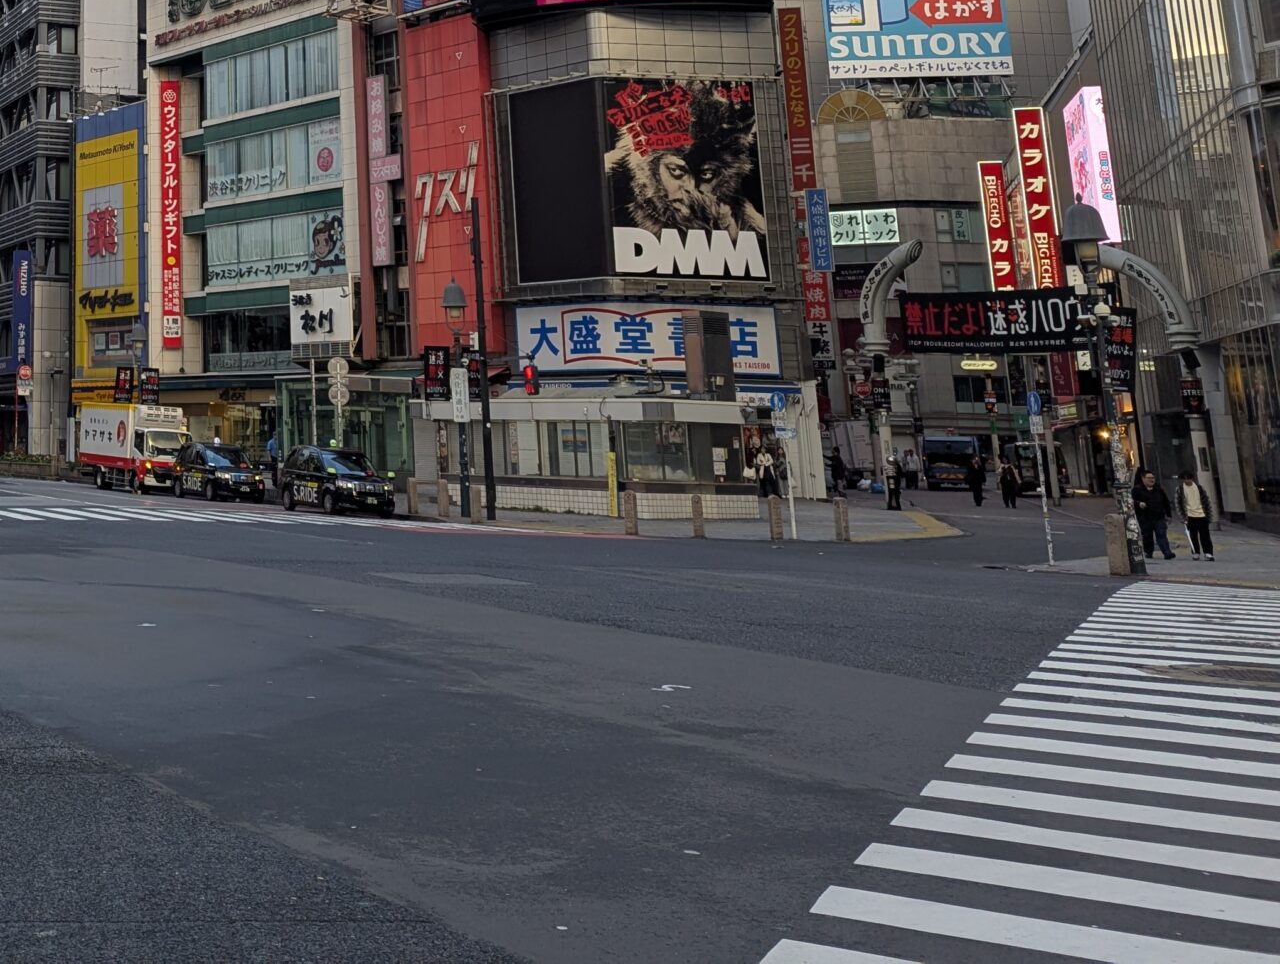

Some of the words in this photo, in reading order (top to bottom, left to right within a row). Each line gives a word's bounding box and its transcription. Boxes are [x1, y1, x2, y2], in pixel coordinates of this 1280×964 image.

[830, 30, 1007, 58] SUNTORY
[783, 13, 807, 127] クスリのことなら
[370, 81, 386, 154] お好み焼
[163, 105, 178, 253] ウィンターフルーツギフト
[792, 137, 815, 183] 三千
[1020, 122, 1051, 221] カラオケ
[374, 186, 387, 262] もんじゃ焼
[415, 140, 479, 263] クスリ
[847, 213, 896, 228] れいわ
[87, 206, 118, 258] 薬
[613, 226, 767, 277] DMM
[810, 193, 829, 268] 大盛堂商事ビル
[833, 229, 897, 244] クリニック
[20, 259, 28, 297] MIZUHO
[804, 272, 827, 320] 輪焼肉
[182, 477, 202, 492] S.RIDE
[293, 487, 319, 504] S.RIDE
